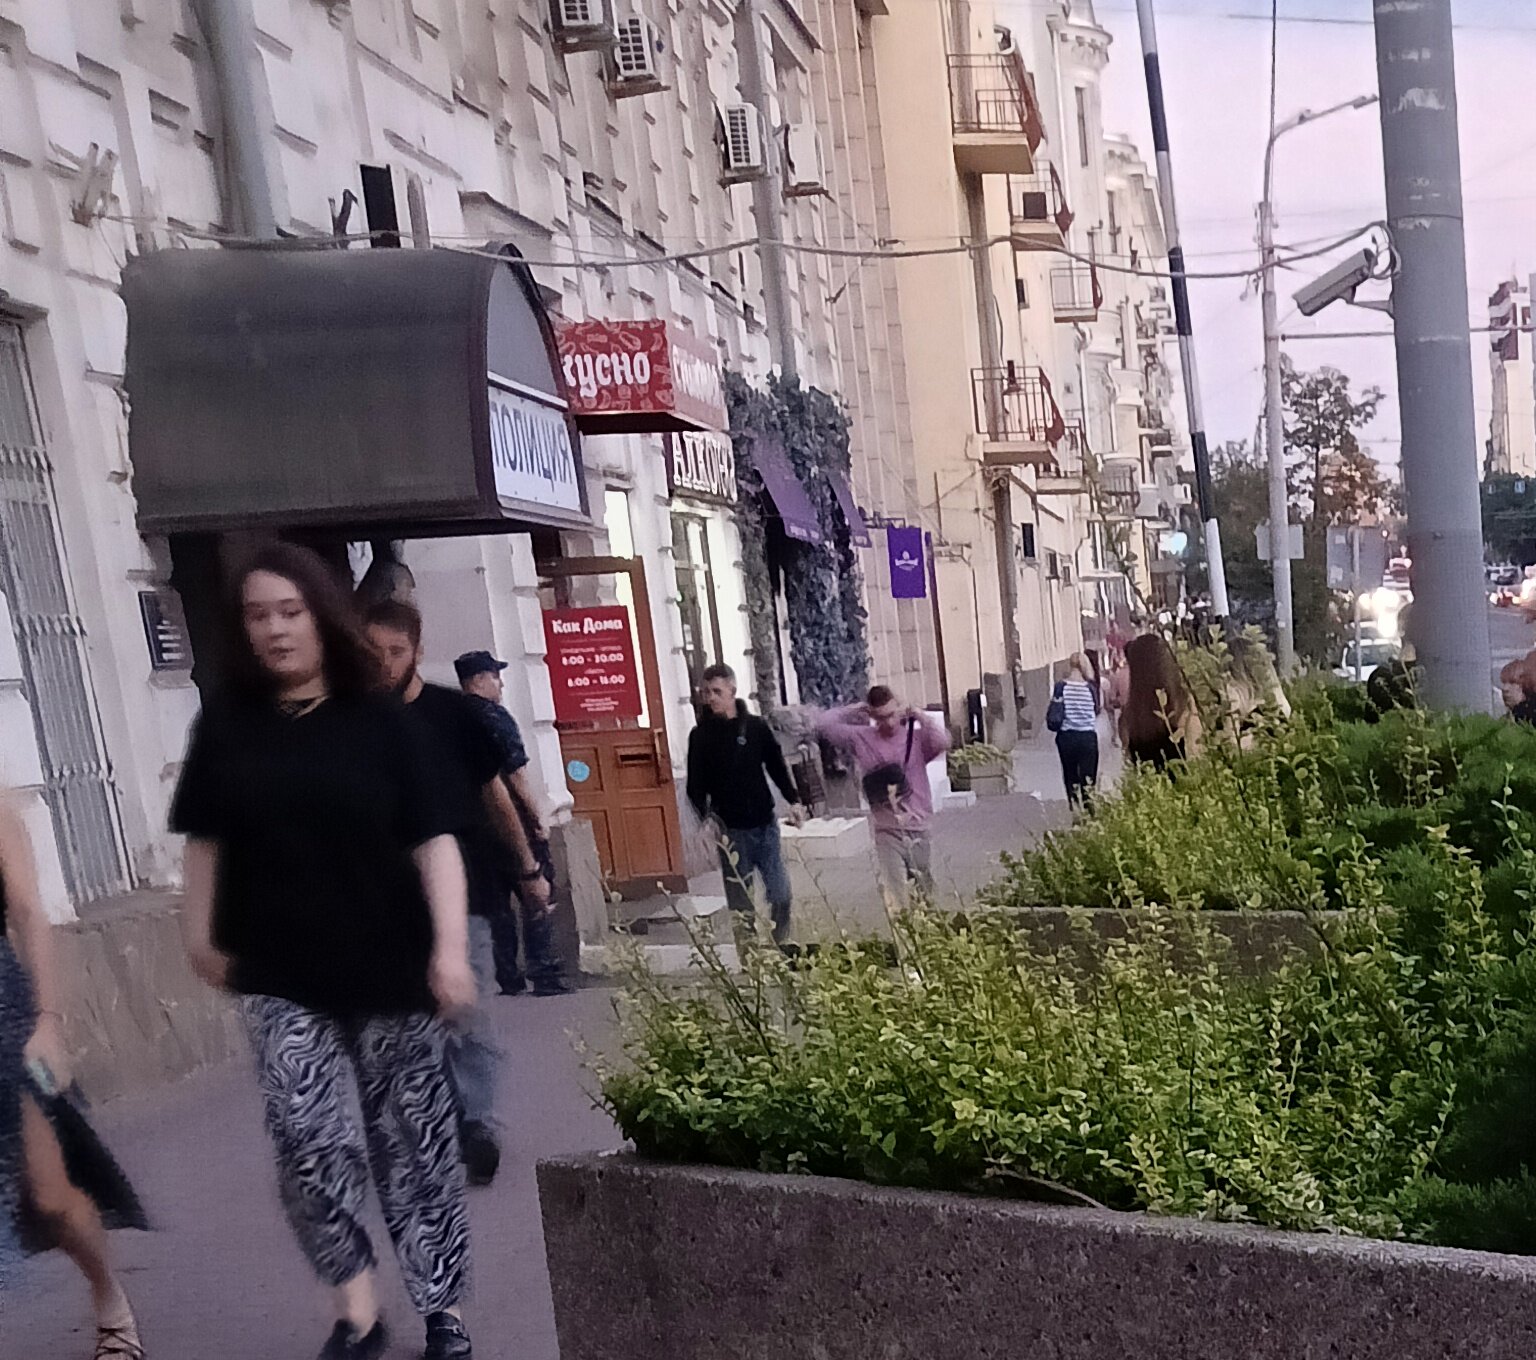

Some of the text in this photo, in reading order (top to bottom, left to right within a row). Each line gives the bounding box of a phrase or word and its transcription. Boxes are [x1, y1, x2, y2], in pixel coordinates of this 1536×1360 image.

[491, 400, 573, 492] ПОЛИЦИЯ
[552, 617, 624, 634] Как Дома
